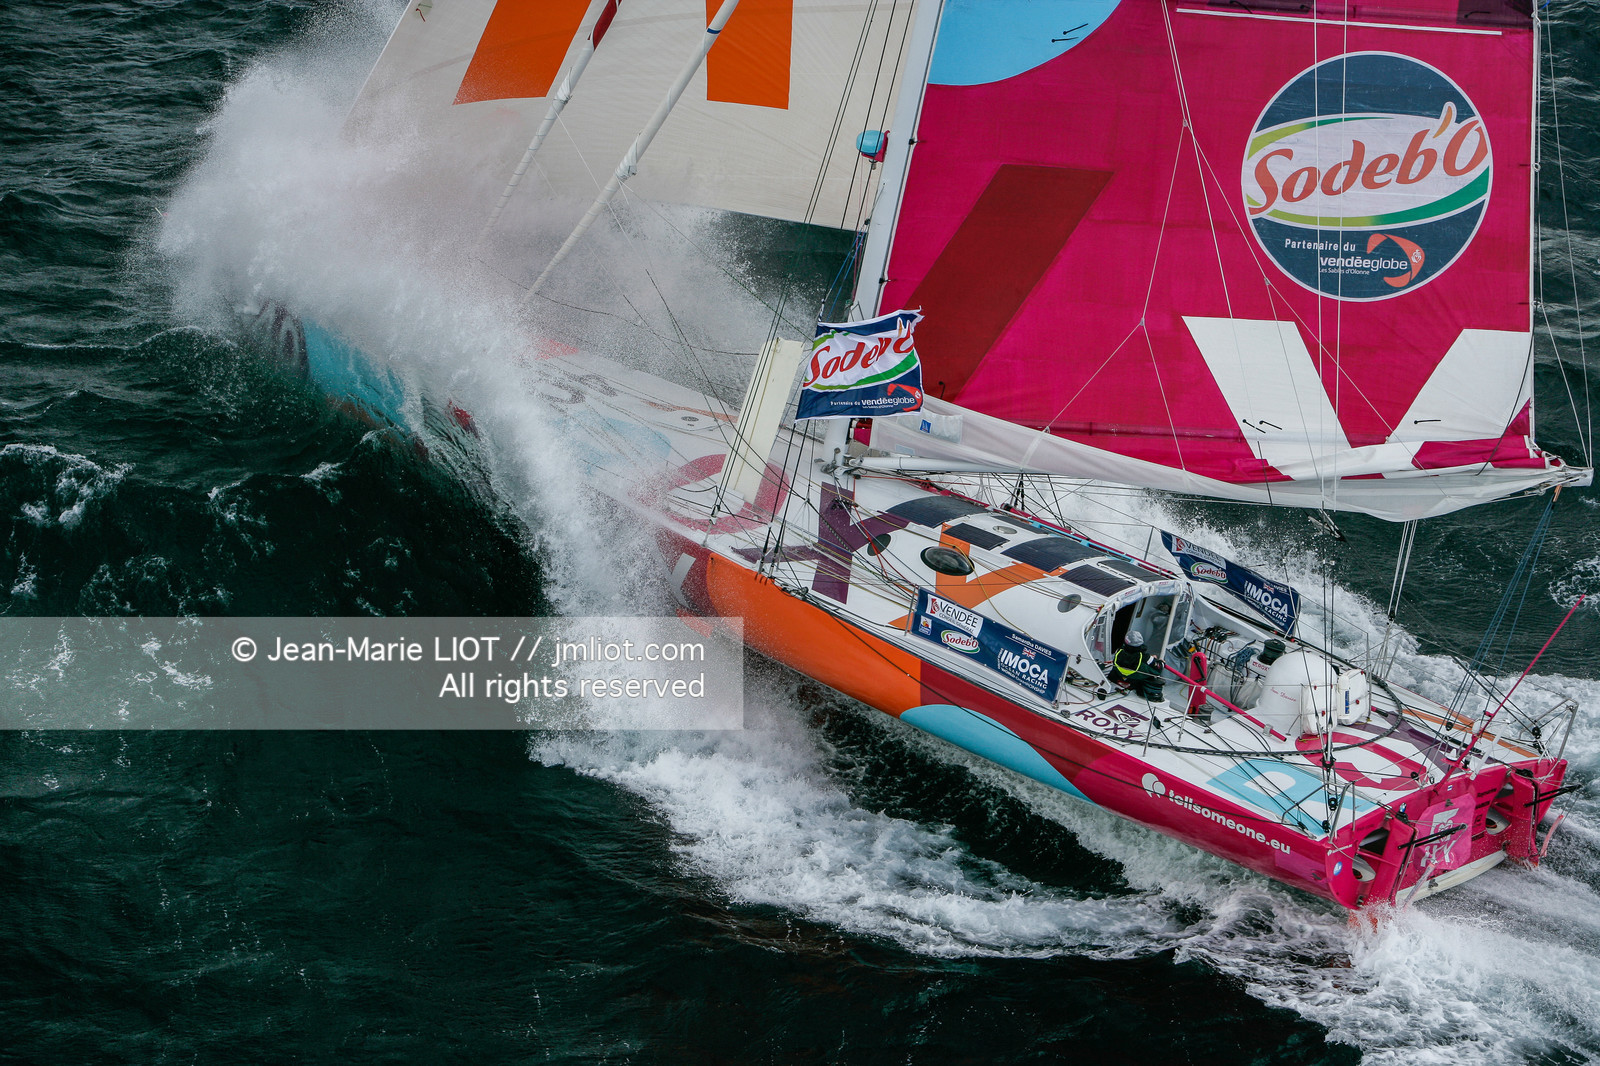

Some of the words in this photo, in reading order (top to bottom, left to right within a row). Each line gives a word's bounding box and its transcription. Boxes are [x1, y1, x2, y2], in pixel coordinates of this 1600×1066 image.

[1248, 106, 1488, 215] Sodeb'O
[1285, 238, 1339, 251] Partenaire
[1343, 241, 1356, 251] du
[941, 602, 978, 628] VENDÉE
[1247, 582, 1288, 617] IMOCA
[1001, 650, 1048, 684] IMOCA
[1022, 674, 1047, 689] RACING
[1075, 709, 1143, 740] ROXY
[1169, 789, 1291, 855] tellsomeone.eu
